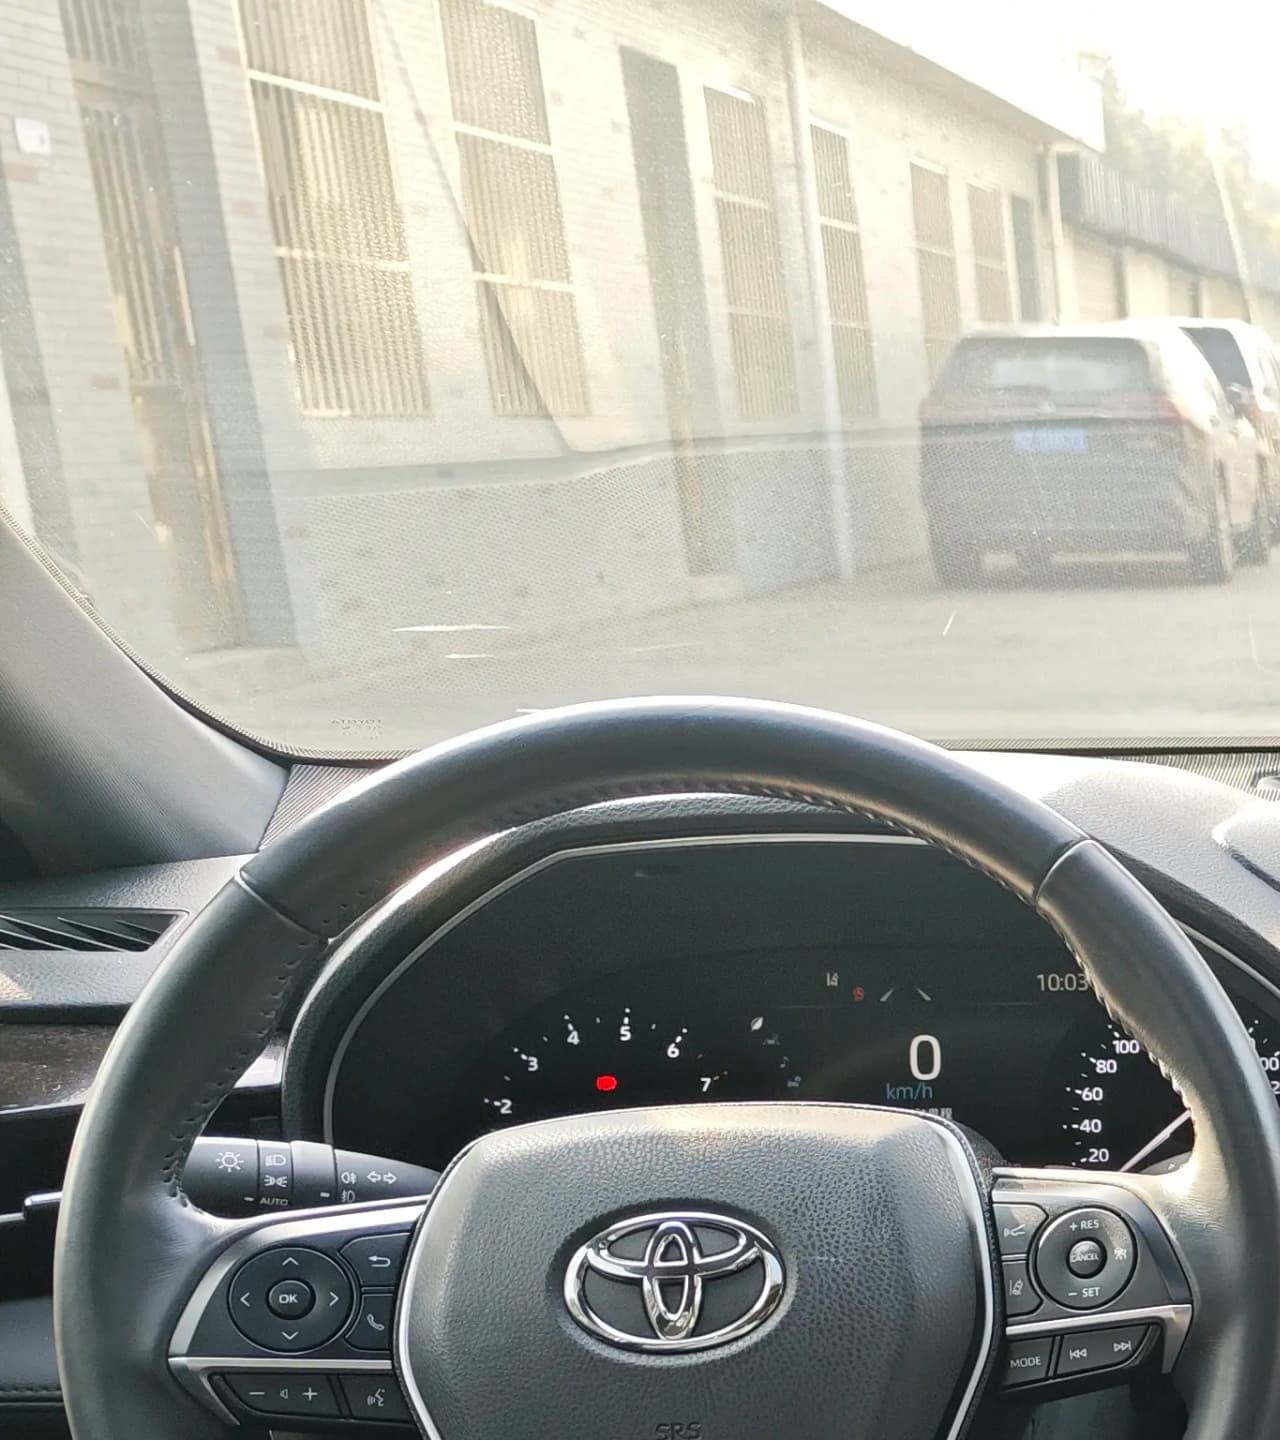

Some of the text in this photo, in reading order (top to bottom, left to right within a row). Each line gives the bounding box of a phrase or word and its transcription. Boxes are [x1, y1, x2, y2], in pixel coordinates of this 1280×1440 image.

[1036, 973, 1090, 992] 10:03
[566, 1031, 580, 1045] 4
[620, 1026, 632, 1042] 5
[666, 1043, 680, 1059] 6
[1112, 1040, 1140, 1054] 100
[527, 1056, 539, 1072] 3
[909, 1034, 942, 1081] 0
[1095, 1059, 1118, 1074] 80
[700, 1077, 712, 1093] 7
[886, 1082, 933, 1101] km/h
[1081, 1086, 1103, 1101] 60
[500, 1099, 513, 1115] 2
[1079, 1118, 1102, 1134] 40
[1088, 1148, 1109, 1162] 20
[259, 1197, 289, 1207] AUTO
[1080, 1219, 1100, 1230] RES
[1070, 1253, 1099, 1263] CANCEL
[278, 1291, 299, 1306] OK
[1081, 1287, 1101, 1298] SET
[1009, 1355, 1042, 1369] MODE
